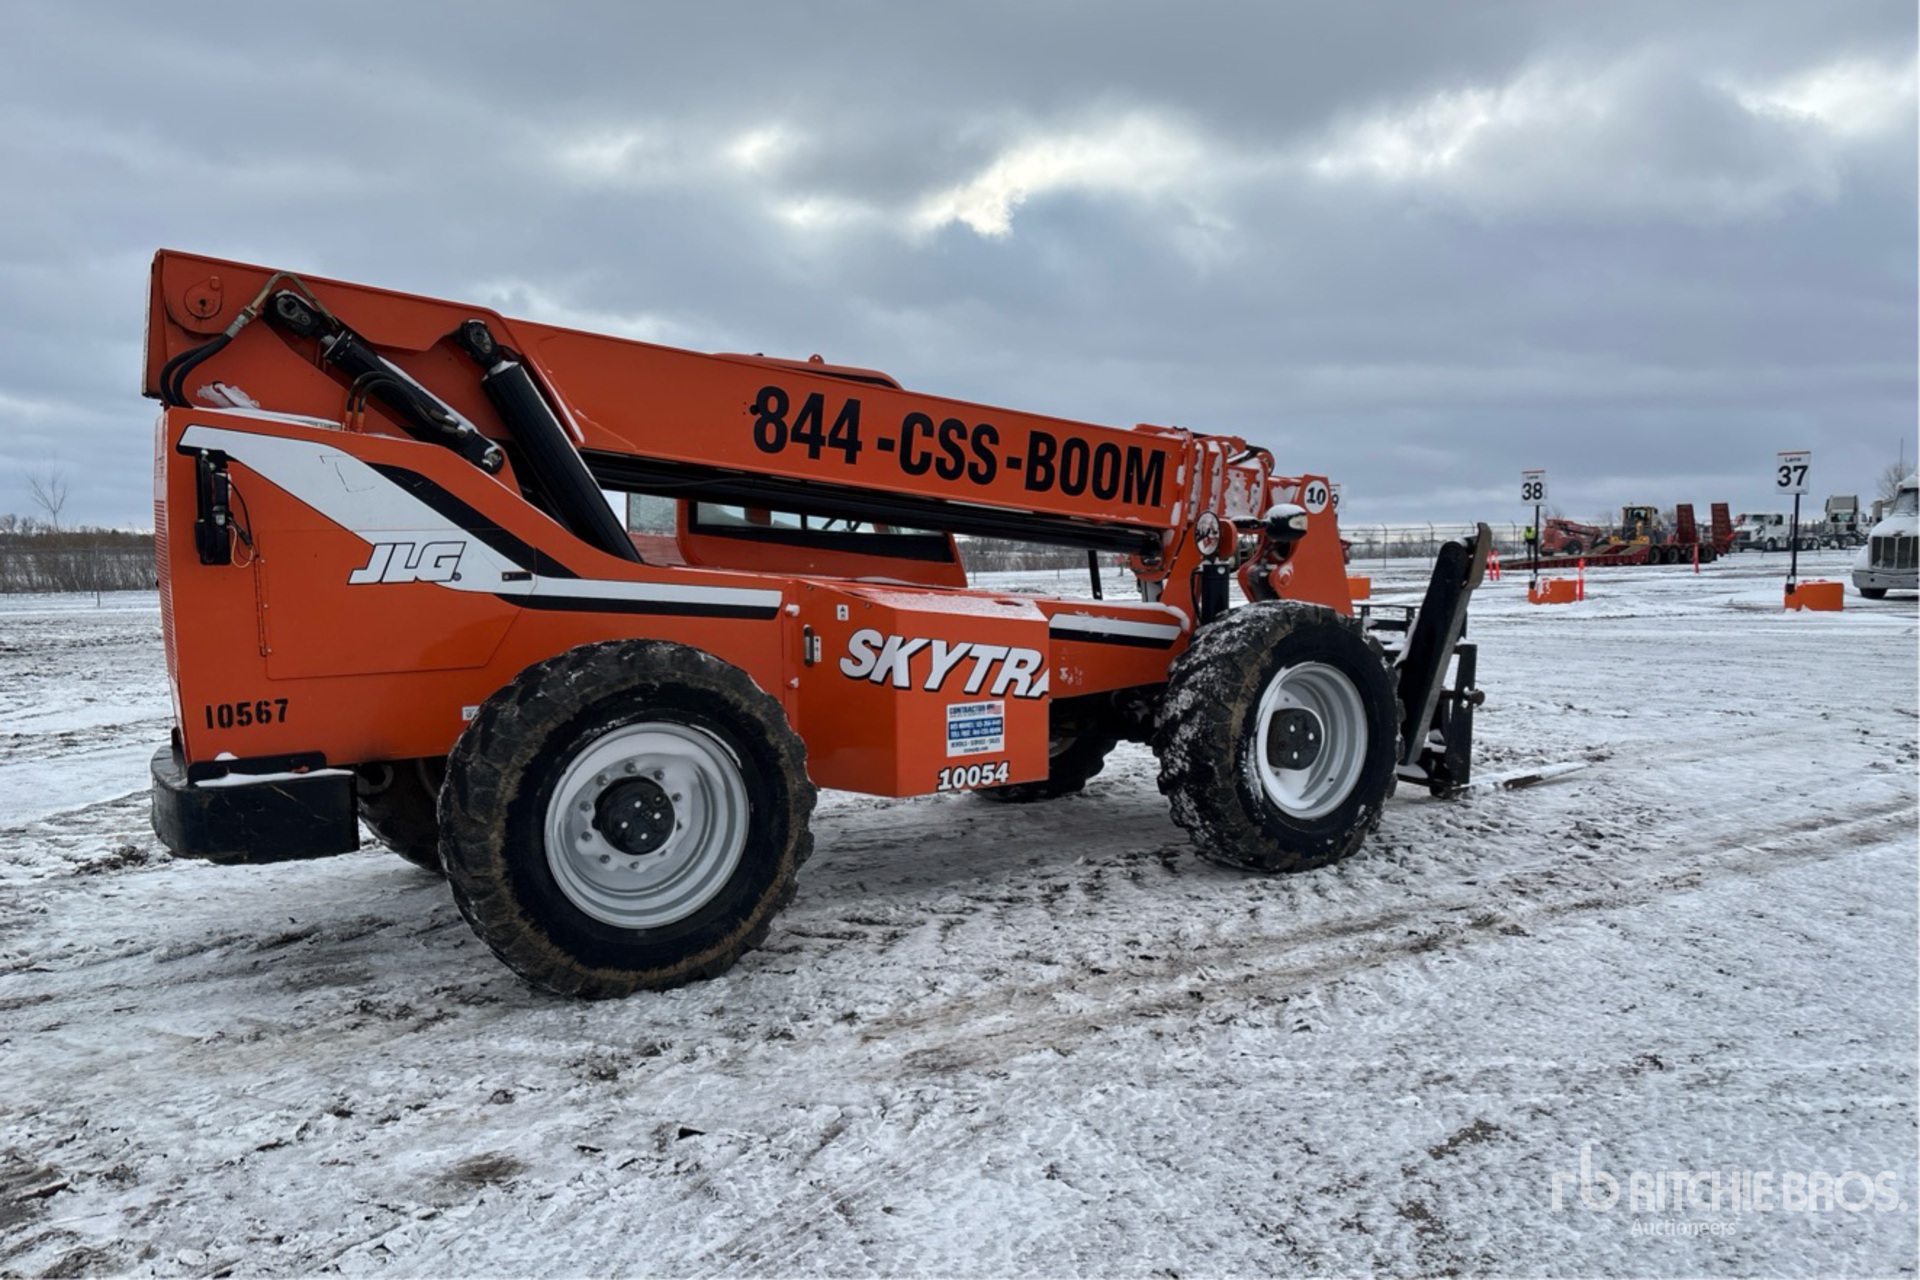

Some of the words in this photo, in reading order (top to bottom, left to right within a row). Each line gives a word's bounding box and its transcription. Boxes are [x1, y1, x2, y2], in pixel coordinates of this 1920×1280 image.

[1777, 465, 1808, 487] 37
[1306, 486, 1326, 506] 10
[1522, 482, 1543, 501] 38
[347, 541, 466, 585] JLG
[205, 698, 288, 729] 10567
[938, 761, 1010, 791] 10054
